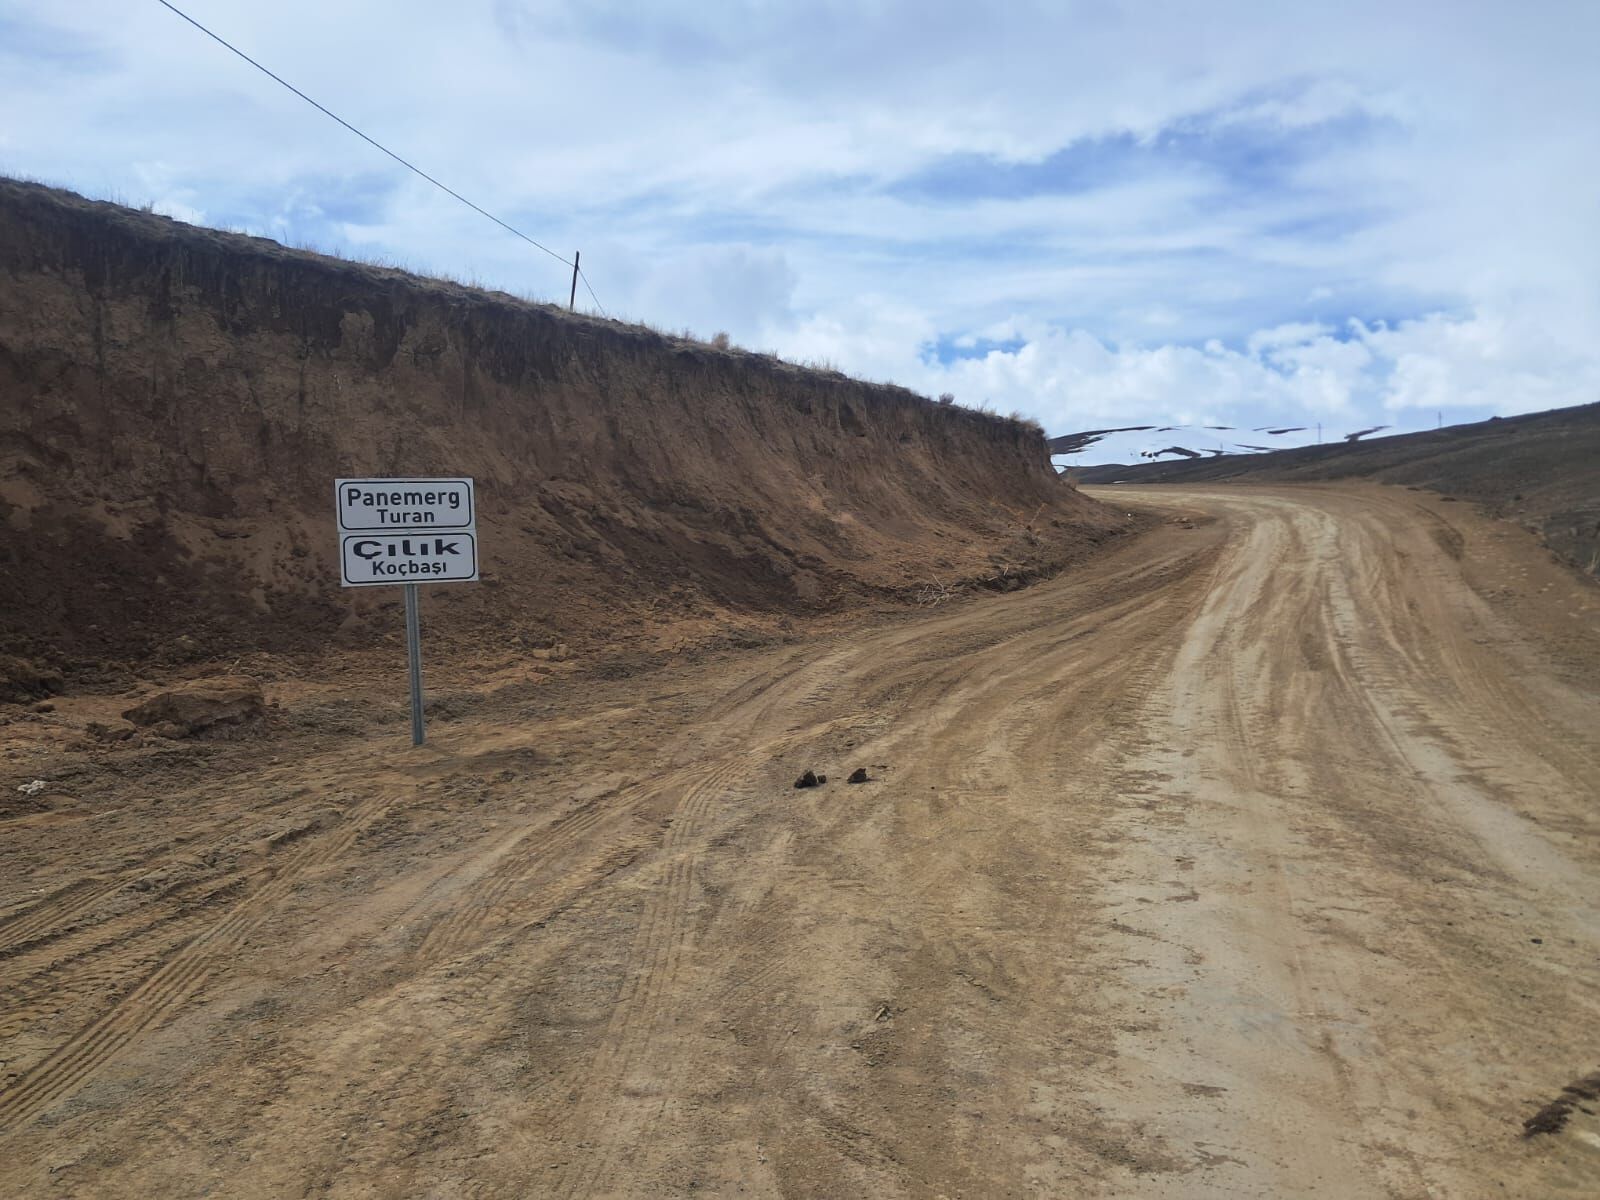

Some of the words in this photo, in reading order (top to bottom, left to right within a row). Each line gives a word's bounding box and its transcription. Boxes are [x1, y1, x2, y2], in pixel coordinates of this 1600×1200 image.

[347, 488, 460, 509] Panemerg
[376, 508, 435, 523] Turan
[372, 560, 447, 576] Koçbaşı
